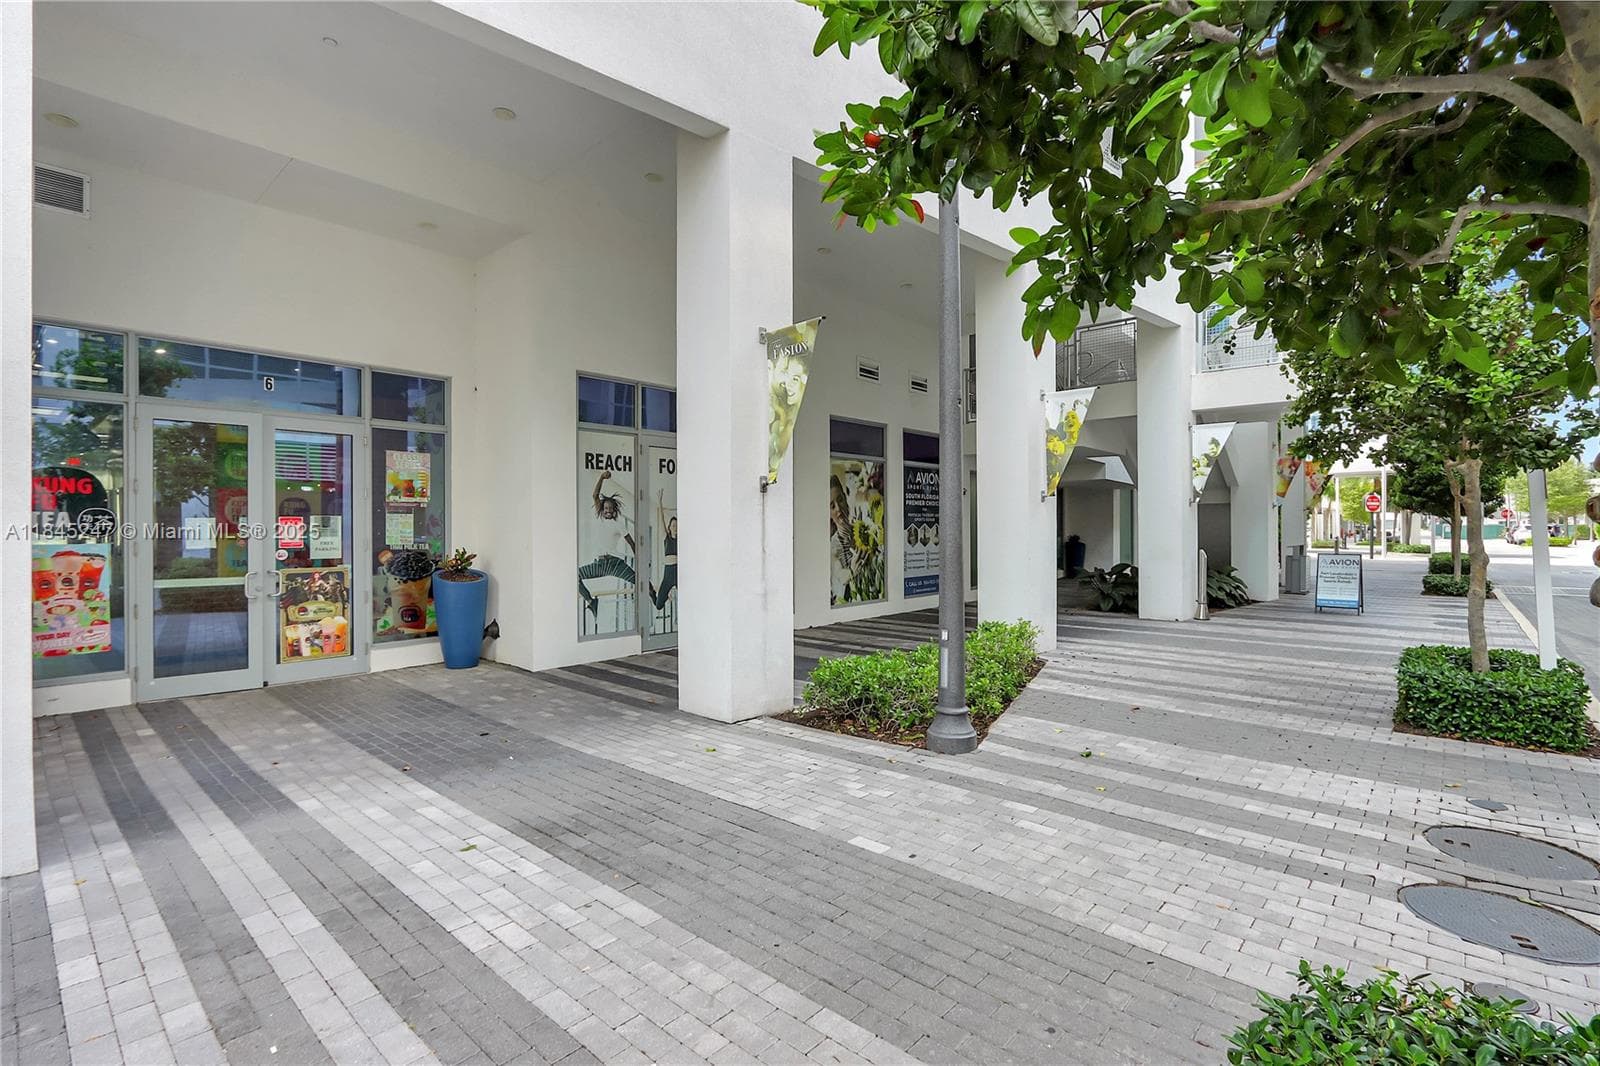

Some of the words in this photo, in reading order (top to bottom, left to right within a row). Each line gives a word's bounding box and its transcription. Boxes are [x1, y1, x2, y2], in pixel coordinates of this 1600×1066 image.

[265, 377, 273, 390] 6
[584, 452, 632, 472] REACH
[658, 458, 676, 475] FO
[32, 476, 93, 494] KUNG
[32, 511, 70, 529] TEA
